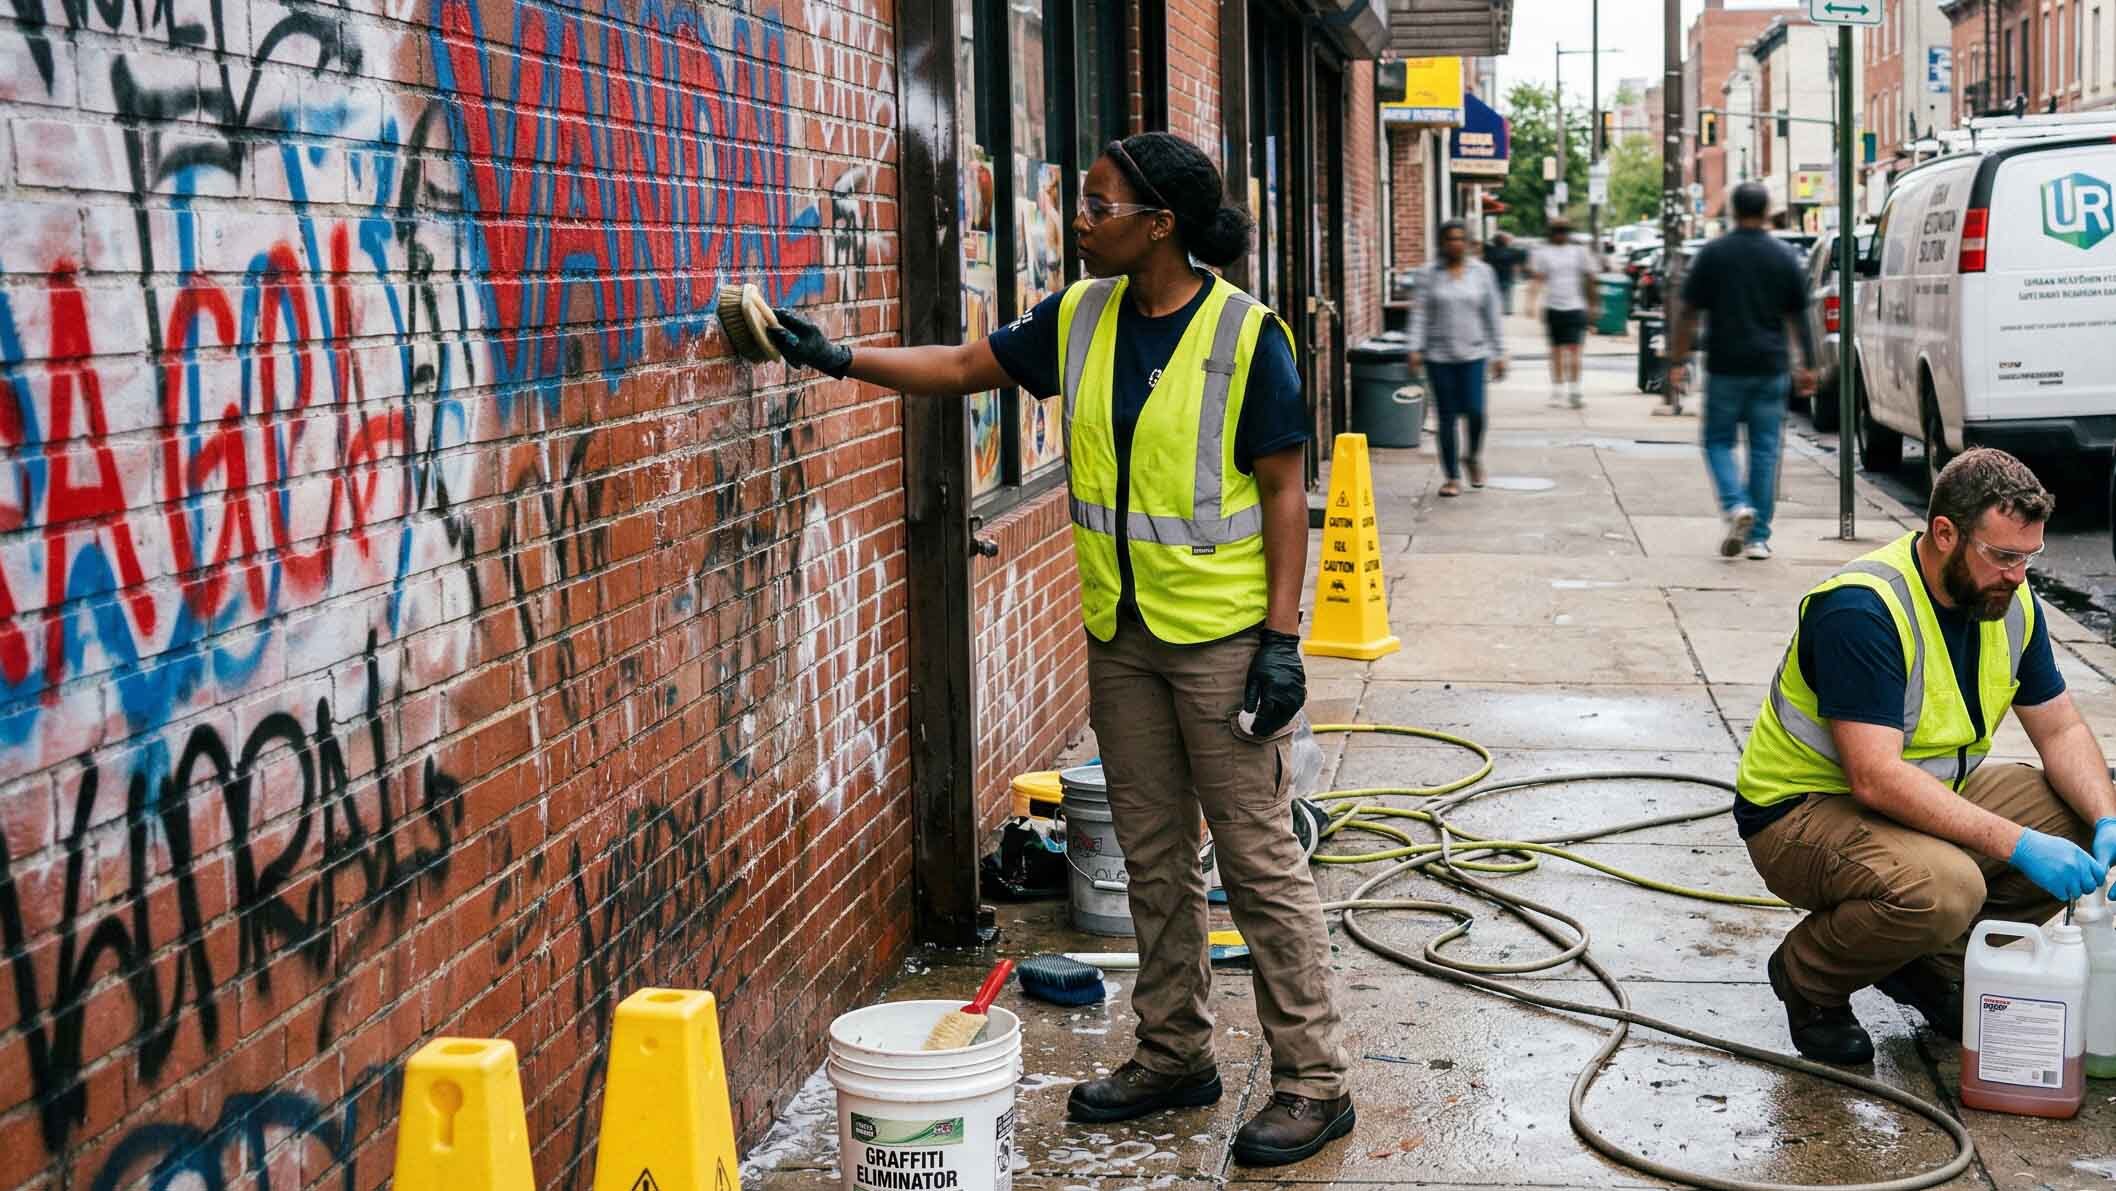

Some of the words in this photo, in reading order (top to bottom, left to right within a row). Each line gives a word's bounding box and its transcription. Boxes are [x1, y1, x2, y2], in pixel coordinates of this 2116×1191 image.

[430, 0, 825, 416] VANDAL
[2047, 178, 2110, 234] UR
[856, 1163, 958, 1190] ELIMINATOR
[865, 1146, 944, 1170] GRAFFITI
